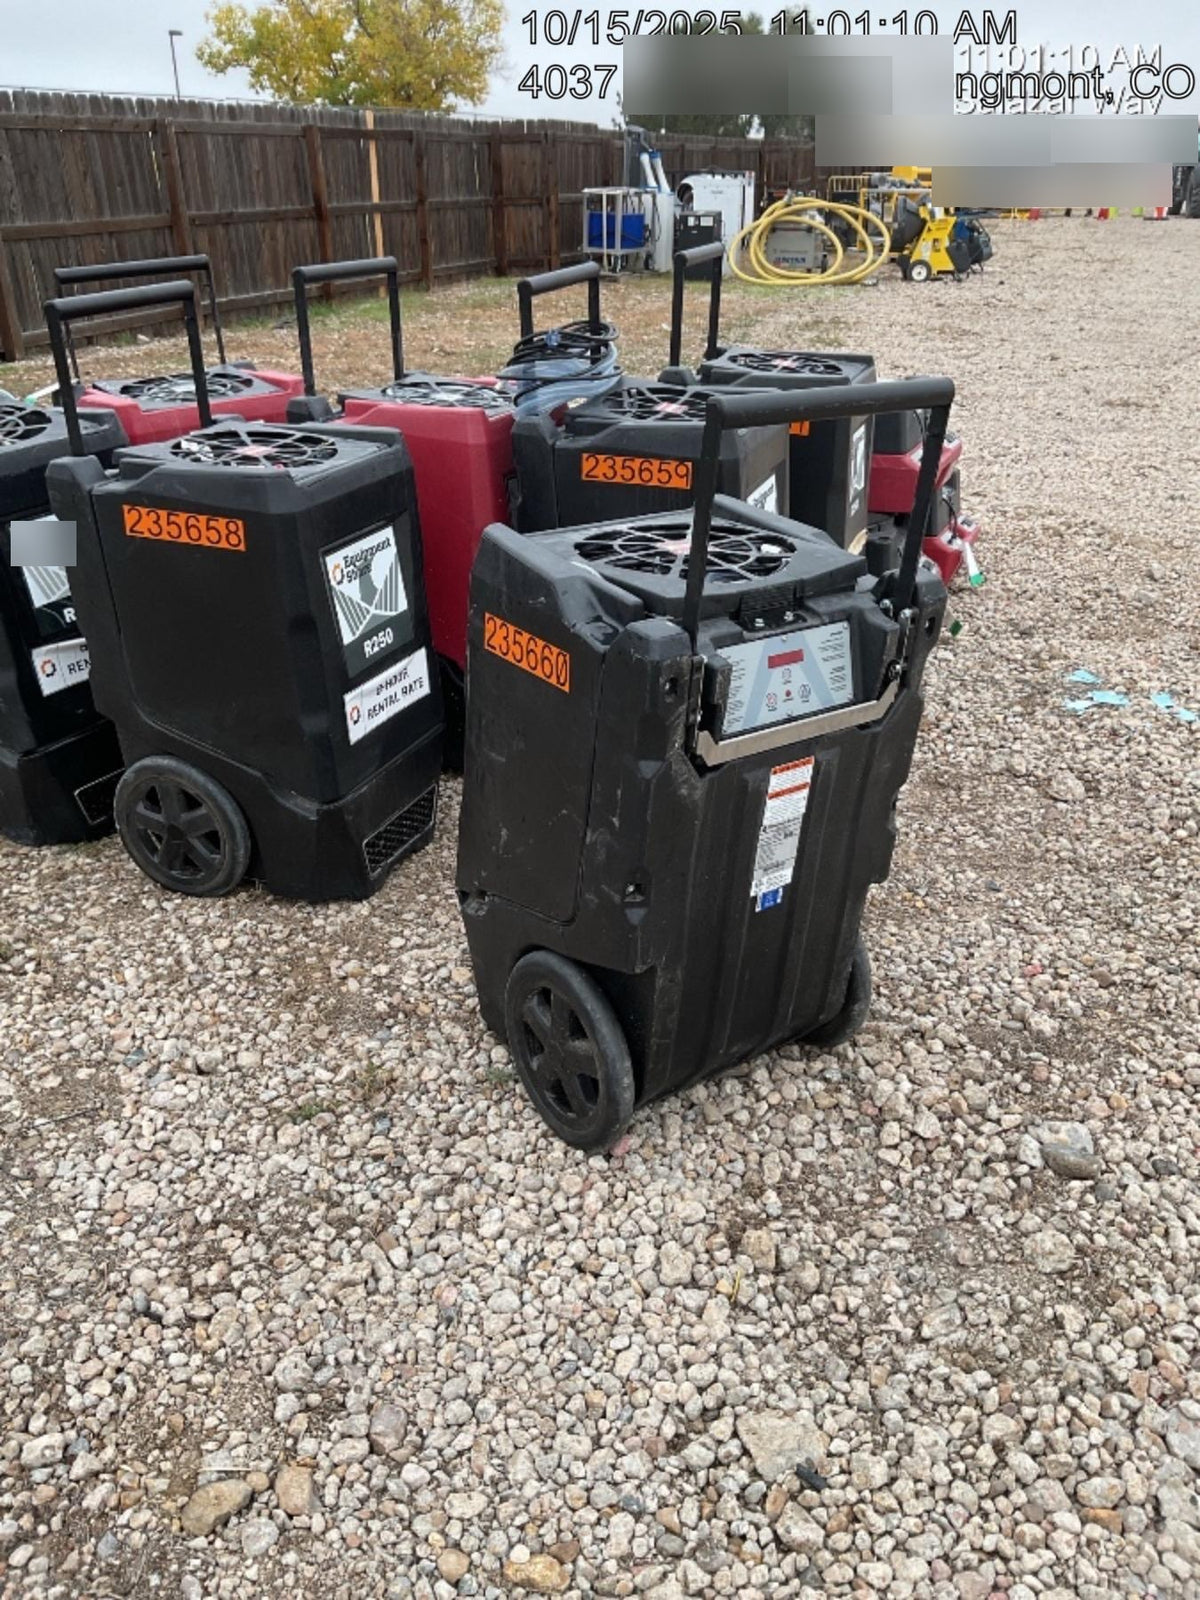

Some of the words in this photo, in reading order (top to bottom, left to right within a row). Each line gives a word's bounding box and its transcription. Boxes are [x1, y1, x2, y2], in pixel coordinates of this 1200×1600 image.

[585, 455, 690, 488] 235659
[127, 507, 242, 547] 235658
[363, 627, 394, 658] R250
[486, 616, 568, 686] 235660
[67, 658, 91, 675] REN
